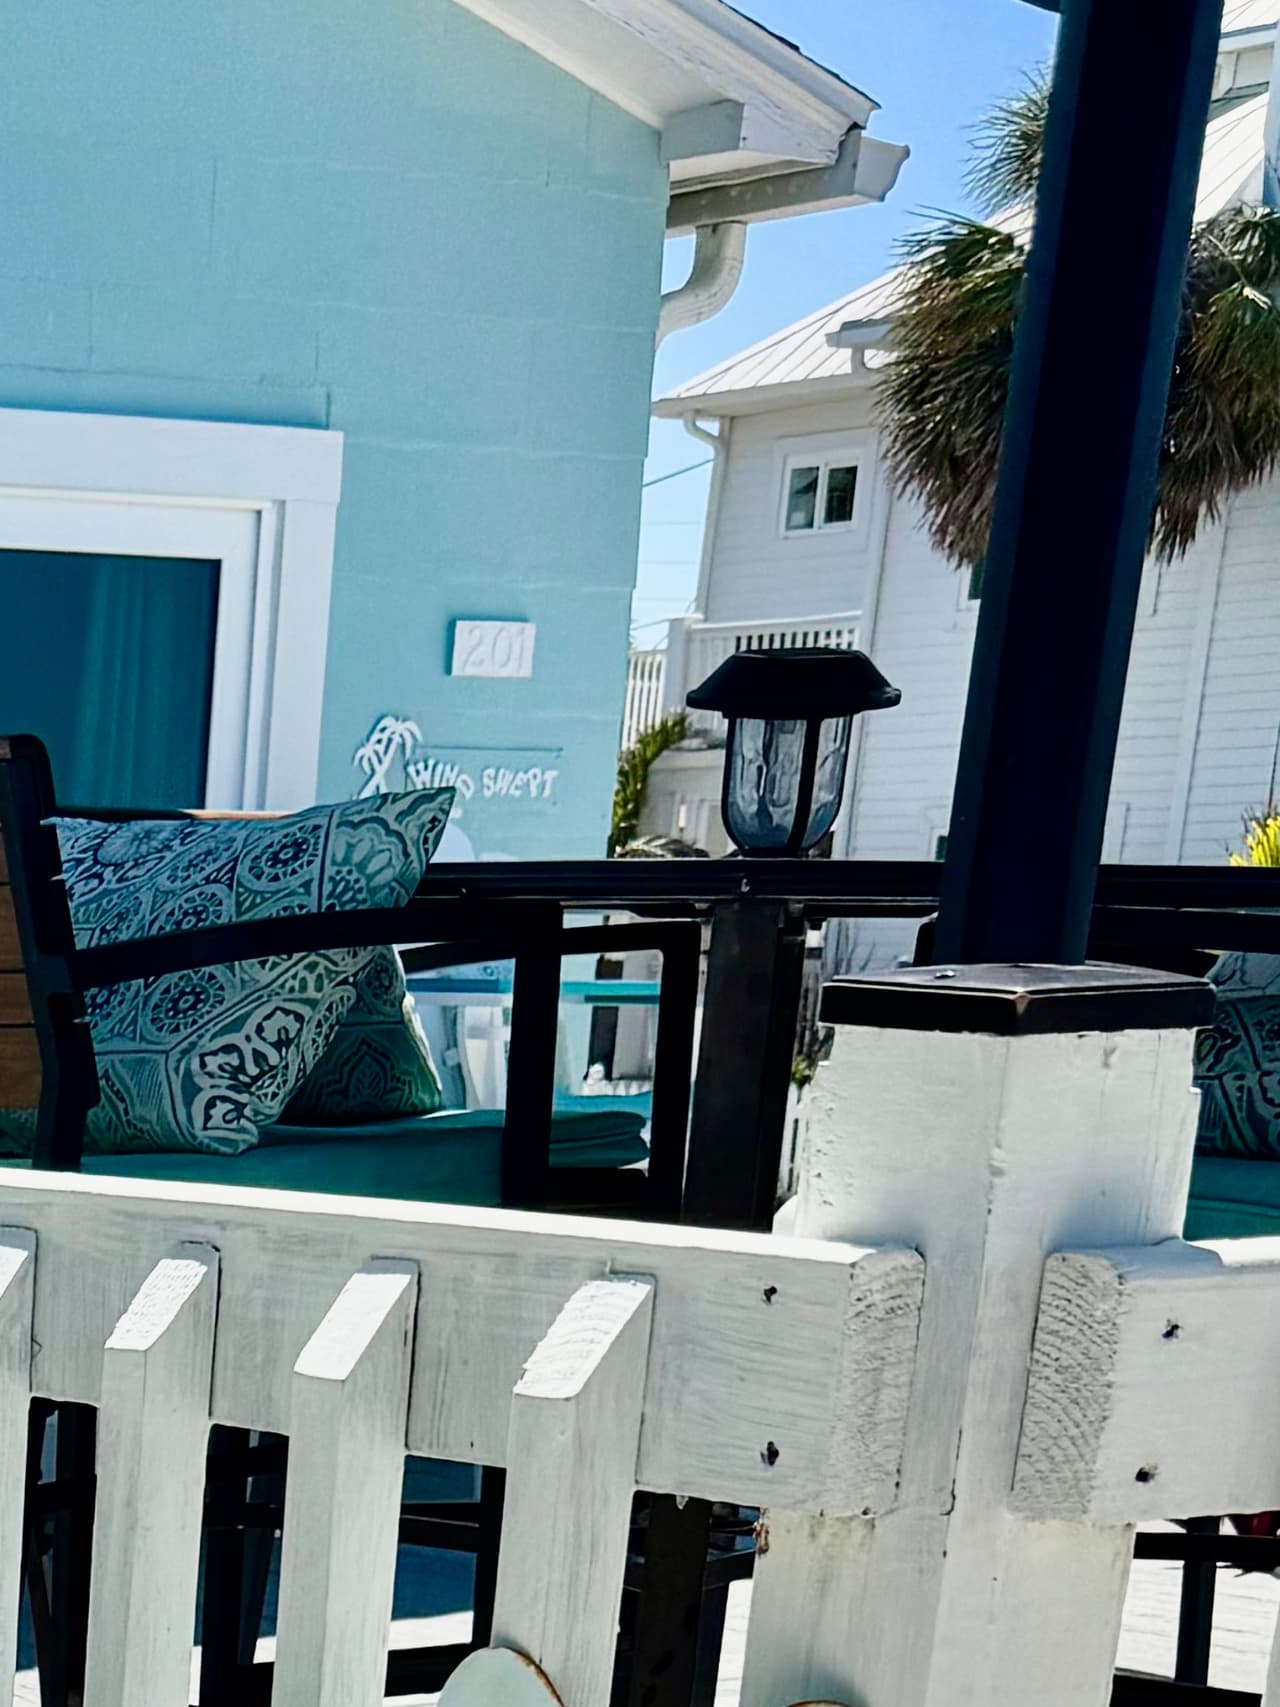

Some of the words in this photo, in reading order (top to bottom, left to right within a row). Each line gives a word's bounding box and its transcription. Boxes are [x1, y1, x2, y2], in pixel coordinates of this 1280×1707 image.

[462, 624, 526, 675] 201
[406, 757, 474, 800] WIND
[482, 766, 560, 798] SWEPT
